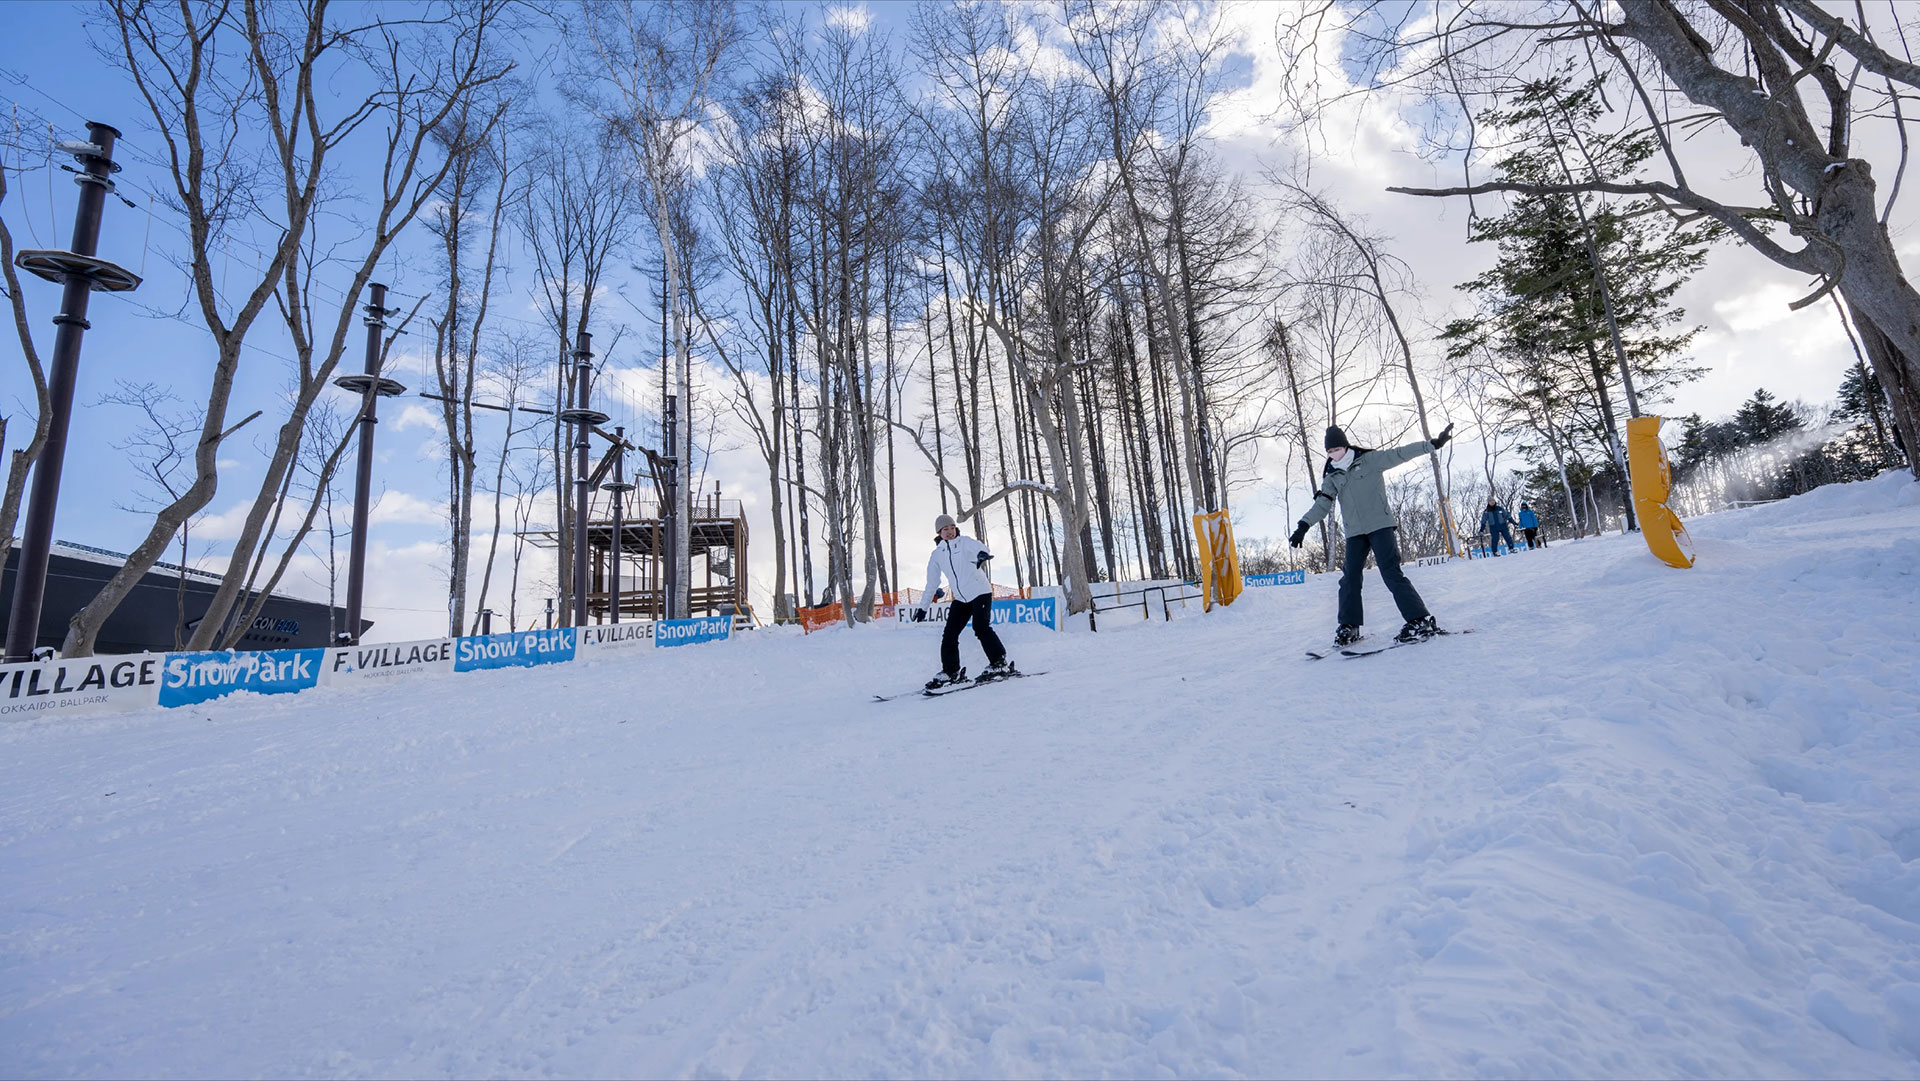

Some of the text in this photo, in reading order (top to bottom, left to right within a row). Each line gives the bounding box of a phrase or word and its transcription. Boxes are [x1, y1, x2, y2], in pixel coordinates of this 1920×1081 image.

[1418, 560, 1424, 568] F
[1246, 572, 1302, 587] Snow Park
[899, 608, 906, 622] F
[1015, 600, 1051, 623] Park
[583, 624, 653, 645] F VILLAGE
[657, 618, 728, 640] Snow Park
[459, 630, 572, 662] Snow Park
[333, 642, 451, 673] F VILLAGE
[167, 652, 313, 689] Snow Park
[60, 695, 110, 708] BALLPARK
